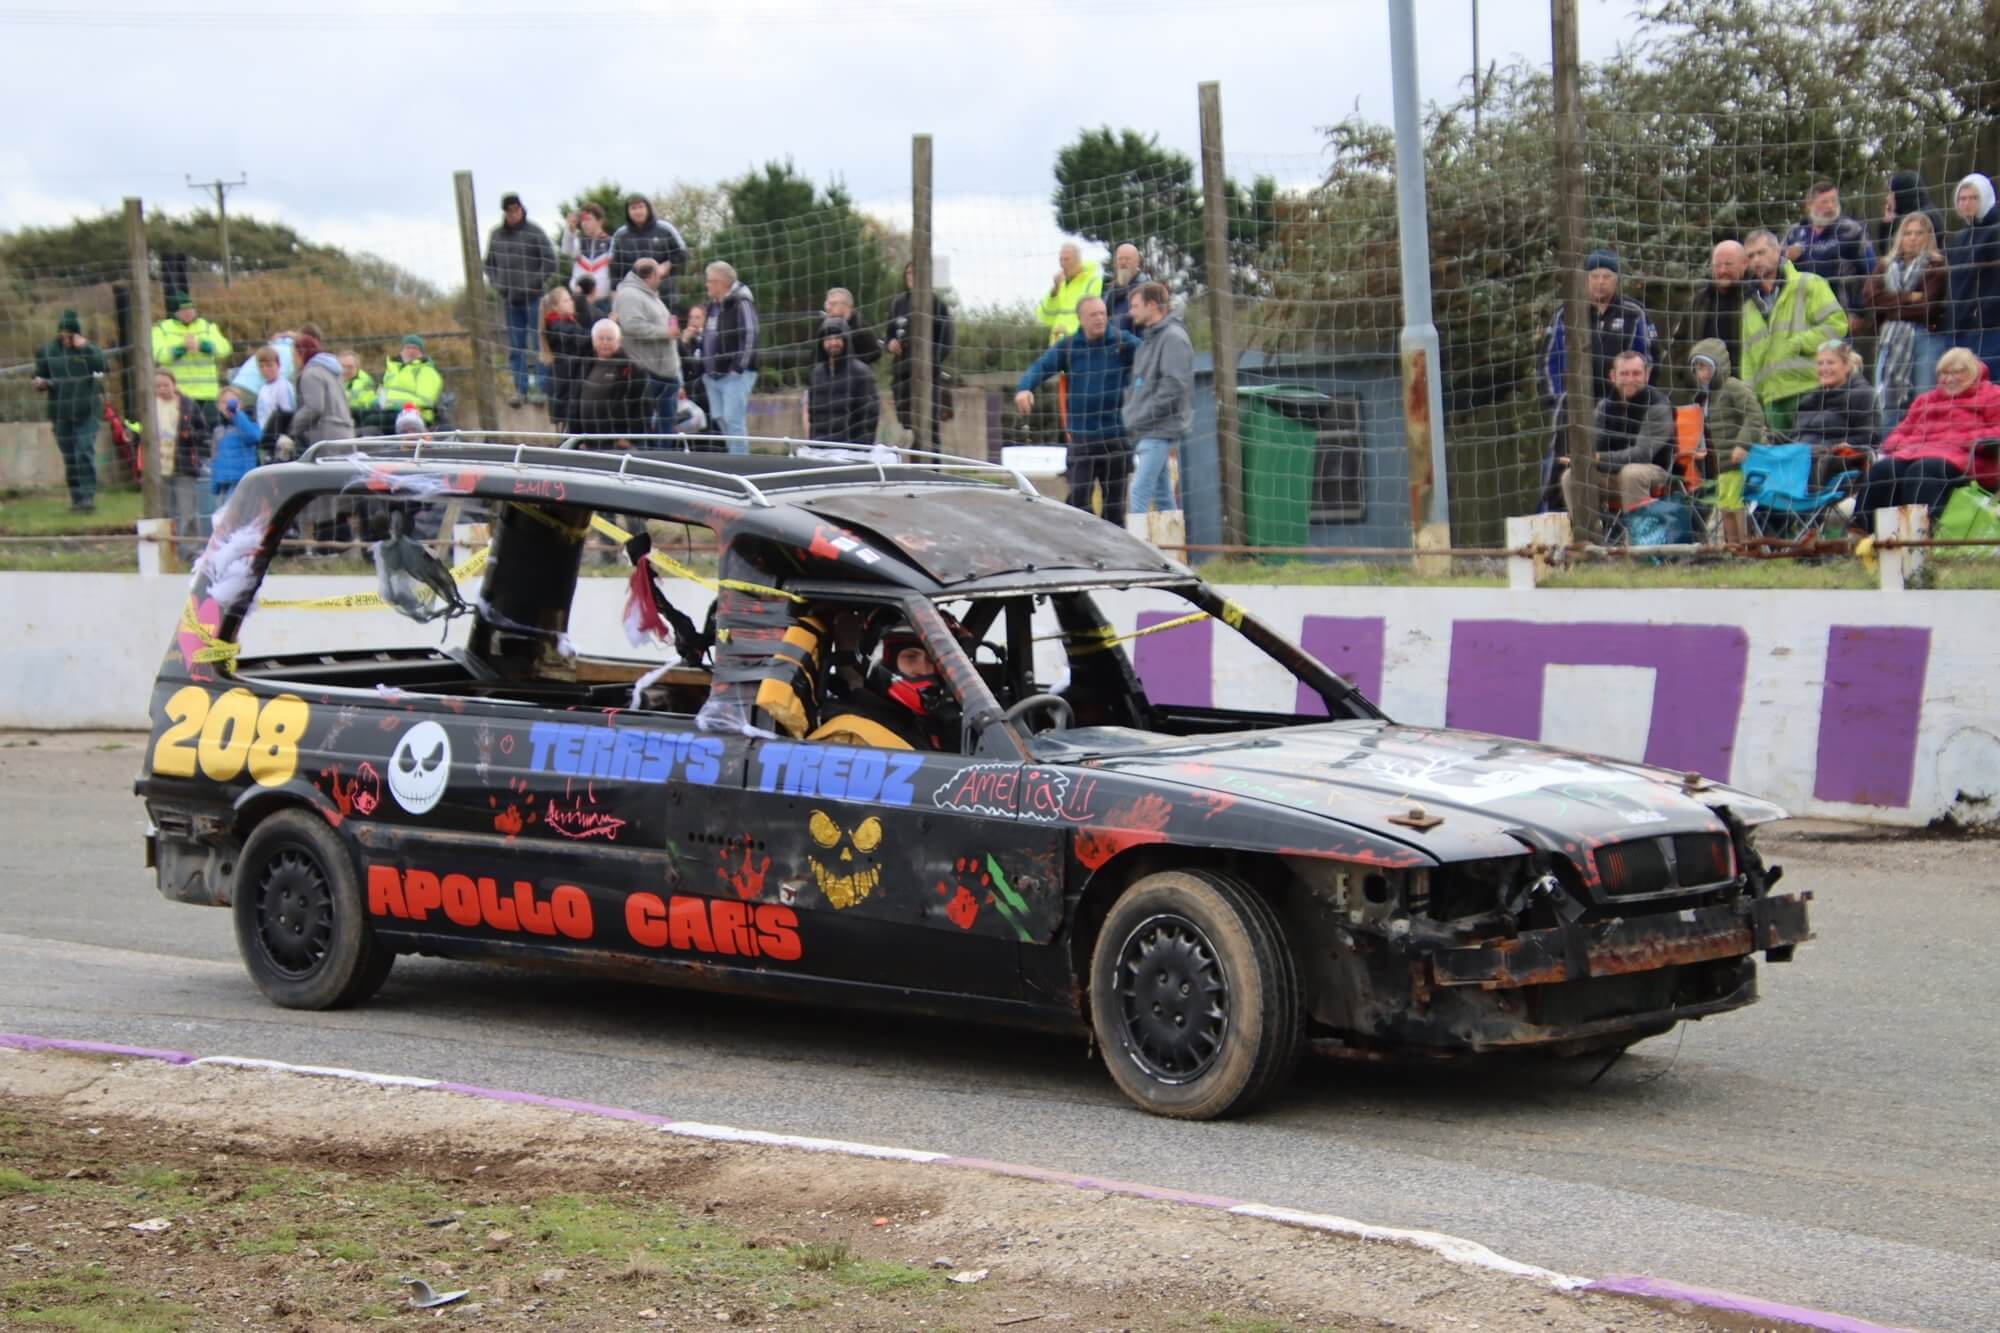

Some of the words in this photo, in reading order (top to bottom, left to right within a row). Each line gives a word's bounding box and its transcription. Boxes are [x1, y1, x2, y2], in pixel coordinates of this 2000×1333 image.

[152, 686, 310, 787] 208
[529, 721, 725, 785] TERRY'S
[758, 742, 925, 806] TREDZ
[367, 864, 594, 940] APOLLO
[625, 891, 802, 961] CARS
